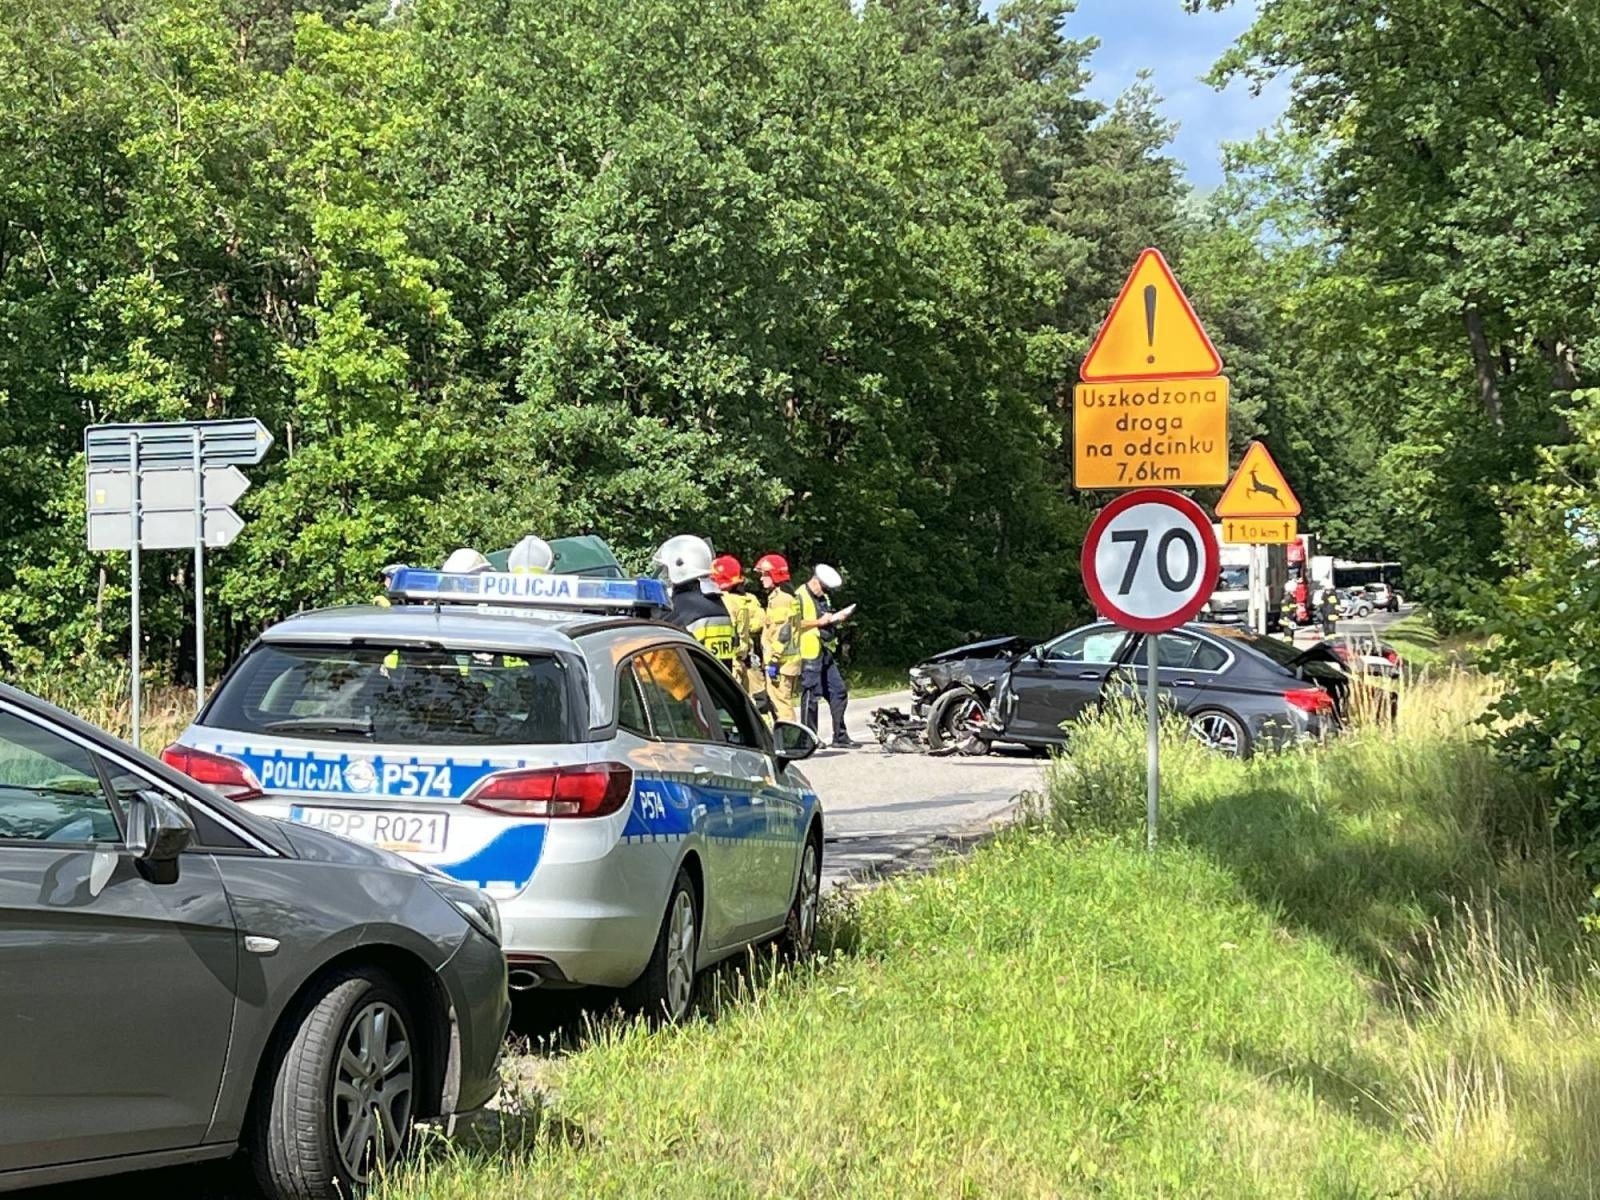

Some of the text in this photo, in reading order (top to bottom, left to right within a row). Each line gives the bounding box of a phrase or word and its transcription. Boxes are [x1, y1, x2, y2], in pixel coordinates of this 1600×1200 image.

[1083, 387, 1217, 408] Uszkodzona
[1115, 413, 1183, 435] droga
[1086, 436, 1214, 457] na odcinku
[1111, 527, 1199, 595] 70
[483, 578, 570, 597] POLICJA
[262, 759, 451, 796] POLICJA P574
[640, 791, 666, 819] P574
[373, 815, 437, 844] R021
